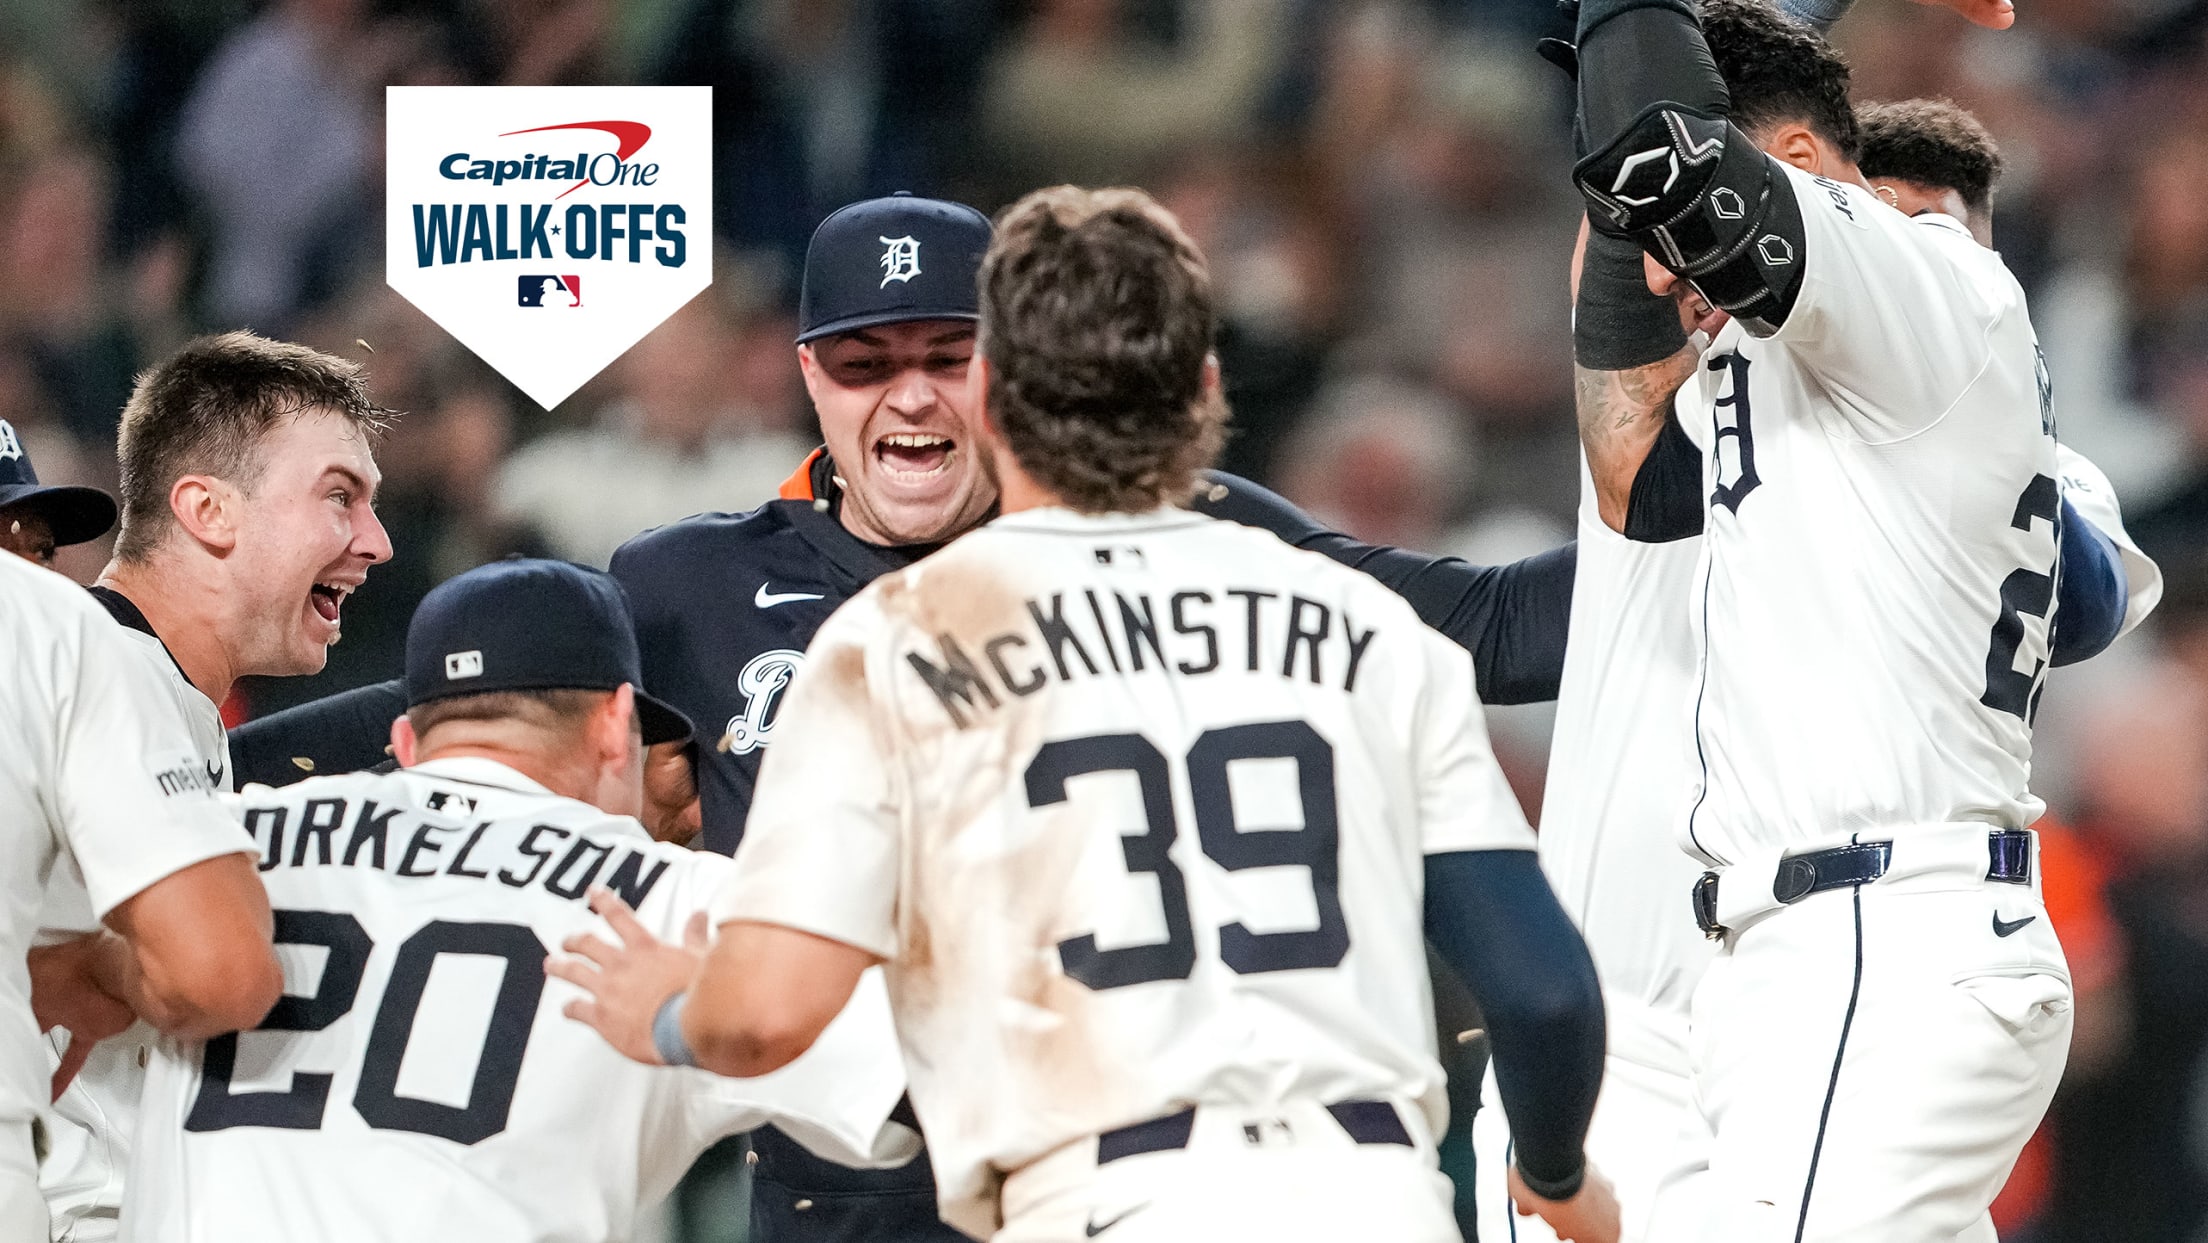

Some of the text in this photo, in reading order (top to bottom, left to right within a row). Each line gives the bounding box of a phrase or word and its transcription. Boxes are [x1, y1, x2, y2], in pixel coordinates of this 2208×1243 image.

[879, 235, 922, 290] D
[1813, 175, 1855, 222] ijer
[1980, 472, 2062, 729] 2
[243, 797, 671, 914] ORKELSON
[1024, 720, 1350, 991] 39
[184, 909, 550, 1146] 20
